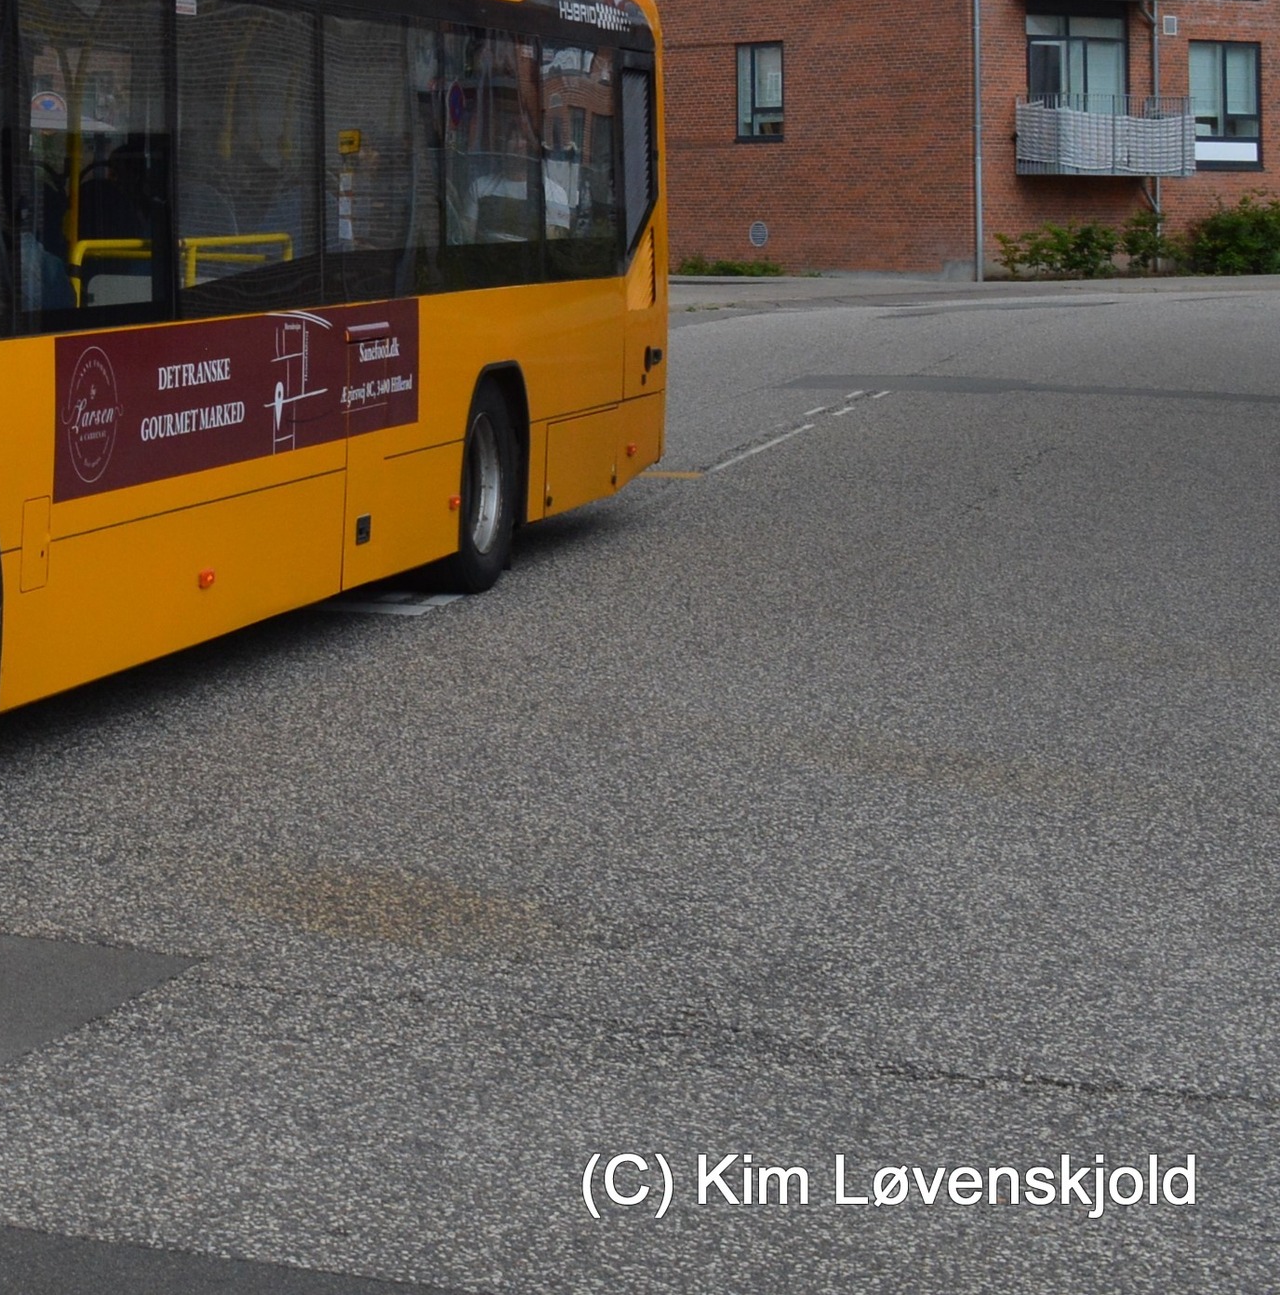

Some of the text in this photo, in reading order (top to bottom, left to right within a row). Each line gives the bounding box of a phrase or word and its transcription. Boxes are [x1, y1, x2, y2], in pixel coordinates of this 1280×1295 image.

[558, 1, 596, 25] HYBRID
[158, 358, 231, 390] DET FRANSKE
[71, 398, 115, 435] Larsen
[141, 401, 245, 442] GOURMET MARKED
